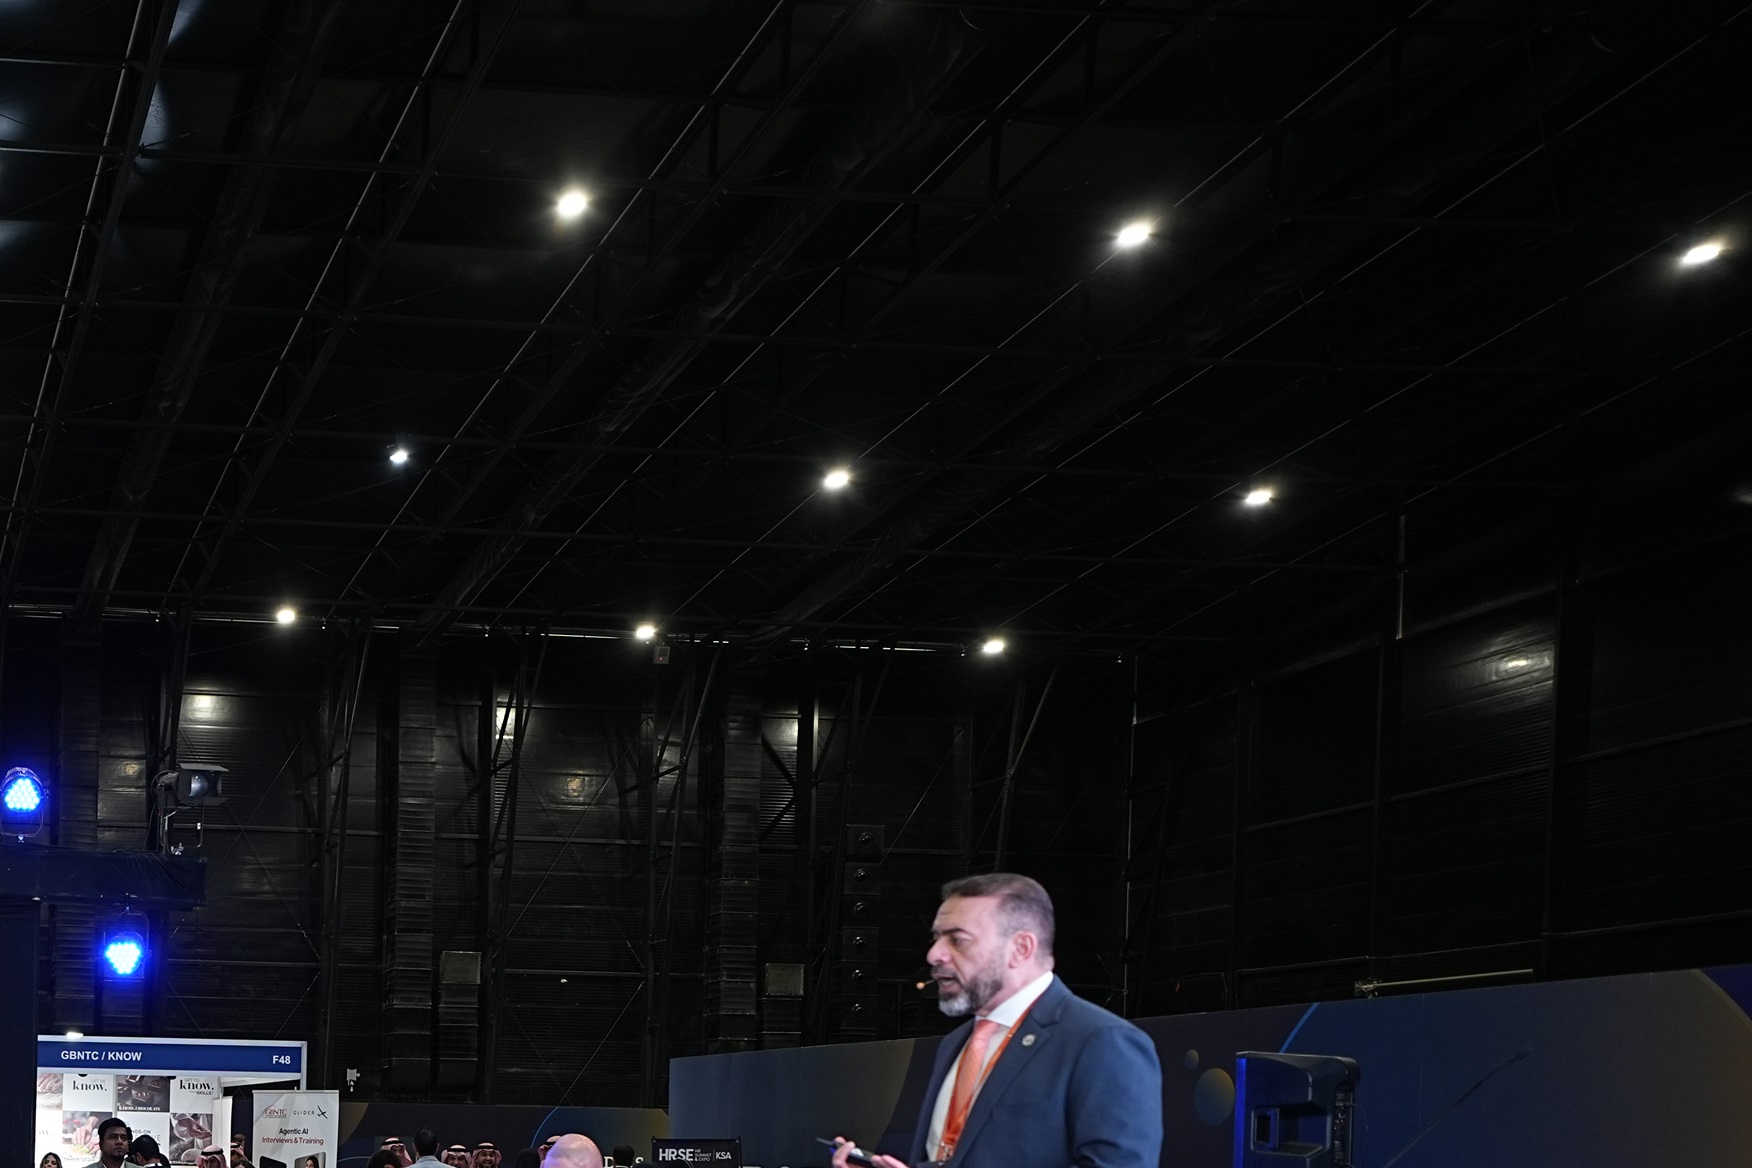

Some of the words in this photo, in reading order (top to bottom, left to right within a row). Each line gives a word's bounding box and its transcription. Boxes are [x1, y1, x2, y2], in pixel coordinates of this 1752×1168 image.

[60, 1050, 99, 1061] GBNTC
[107, 1051, 143, 1062] KNOW
[272, 1054, 291, 1065] F48
[72, 1080, 108, 1092] know.
[179, 1079, 215, 1091] know.
[279, 1128, 301, 1136] Agentic
[262, 1136, 293, 1144] Interviews
[299, 1137, 324, 1146] Training
[658, 1147, 694, 1162] HRSE
[715, 1151, 732, 1160] KSA
